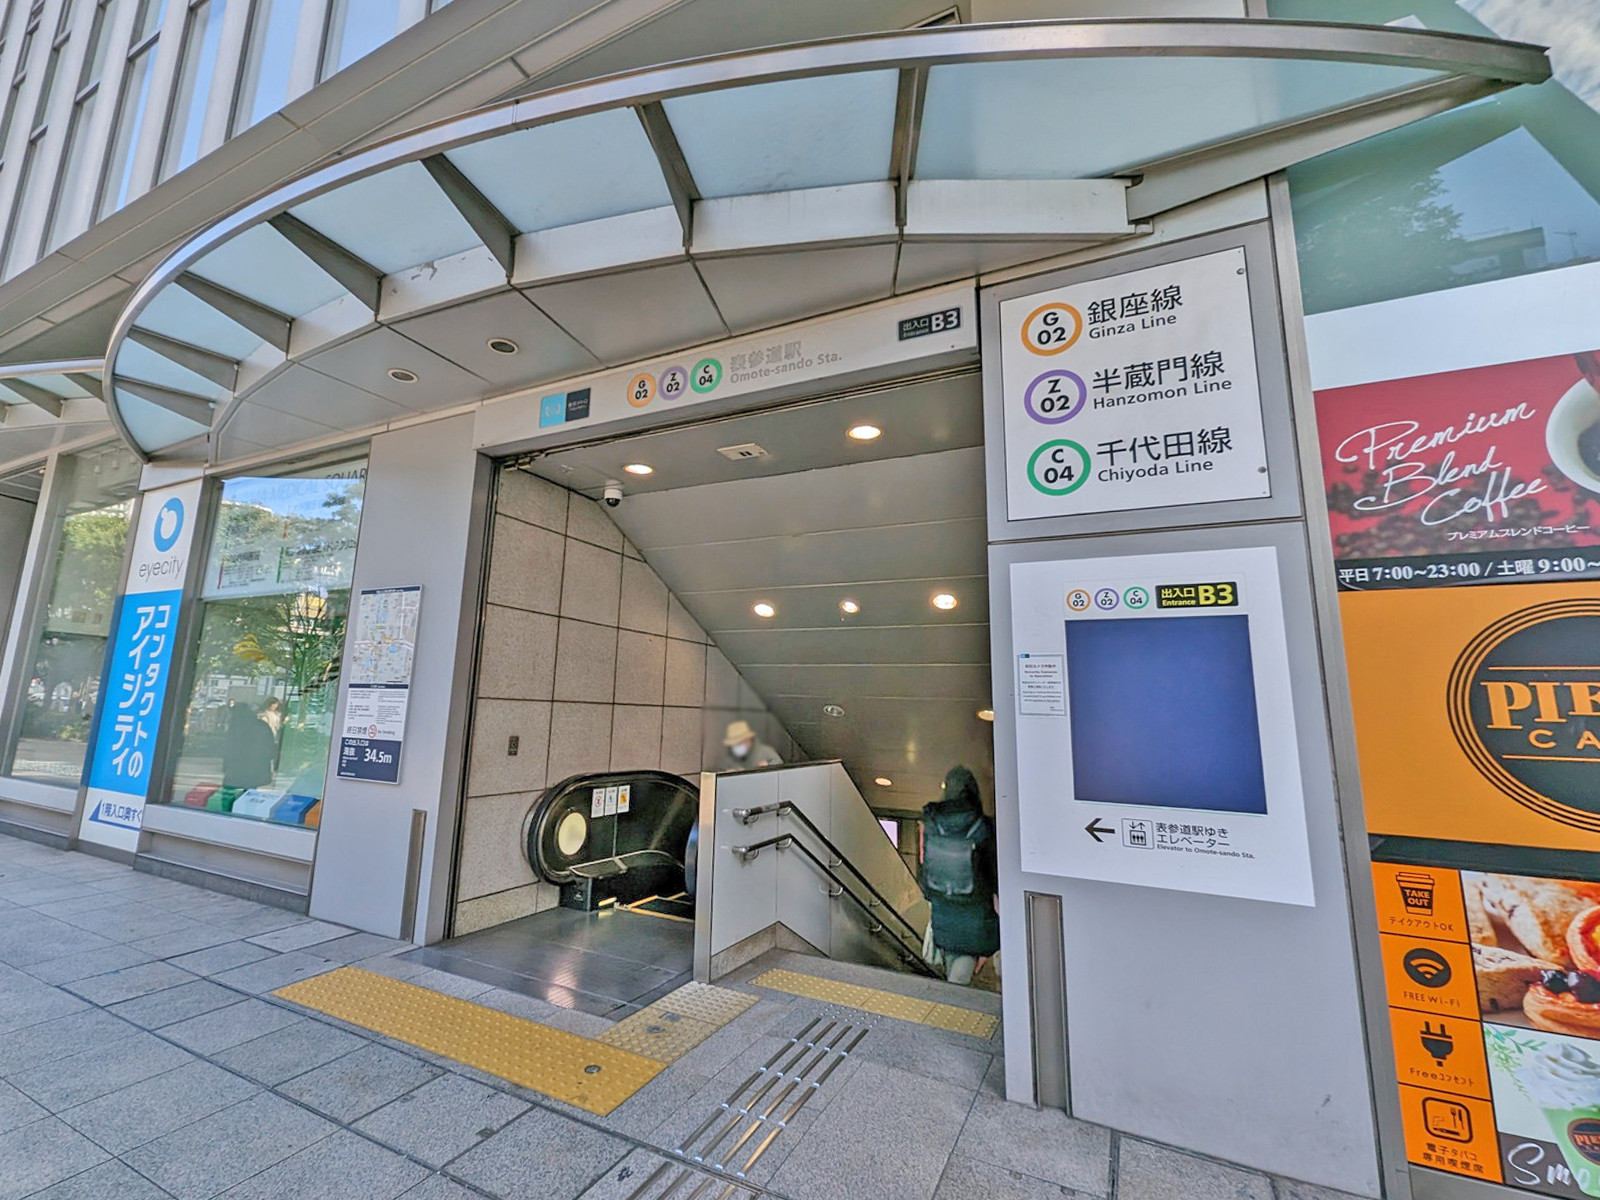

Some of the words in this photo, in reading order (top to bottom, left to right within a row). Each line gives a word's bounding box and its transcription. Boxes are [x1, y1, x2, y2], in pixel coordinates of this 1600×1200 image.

[1087, 285, 1183, 326] 銀座線
[902, 317, 929, 331] 出入口
[931, 310, 958, 331] B3
[1042, 311, 1060, 327] G
[1088, 323, 1136, 340] Ginza
[1141, 313, 1178, 330] Line
[1037, 326, 1067, 345] 02
[729, 340, 802, 372] 表参道駅
[670, 372, 677, 382] Z
[703, 365, 710, 374] C
[730, 357, 813, 384] Omote-sando
[816, 352, 842, 366] Sta.
[1092, 350, 1225, 394] 半蔵門線
[638, 380, 646, 389] G
[666, 382, 681, 393] 02
[699, 374, 714, 386] 04
[1047, 379, 1062, 394] Z
[634, 389, 648, 400] 02
[1093, 386, 1187, 410] Hanzomon
[1194, 379, 1232, 395] Line
[1040, 395, 1071, 414] 02
[1335, 402, 1536, 470] Premium
[1096, 426, 1233, 467] 千代田線
[1051, 448, 1065, 464] C
[1043, 465, 1075, 484] 04
[1097, 464, 1169, 483] Chiyoda
[1176, 460, 1214, 475] Line
[1353, 446, 1502, 511] Blend
[1420, 466, 1548, 526] Coffee
[1447, 525, 1590, 541] プレミアムブレンドコーヒー
[138, 556, 183, 582] eyecity
[1338, 567, 1369, 583] 平日
[1497, 559, 1535, 576] 土曜
[1072, 599, 1084, 607] 02
[1101, 598, 1113, 606] 02
[1130, 597, 1142, 605] 04
[1161, 588, 1195, 599] 出入口
[1198, 583, 1234, 605] B3
[1162, 599, 1196, 607] Entrance
[112, 606, 156, 776] アイシティ
[128, 605, 171, 778] コンタクトの
[363, 747, 392, 765] 34.5m
[1155, 822, 1229, 839] 表参道駅ゆき
[1157, 834, 1230, 848] エレベーター
[1194, 848, 1240, 858] Omote-sando
[1404, 889, 1431, 899] TAKE
[1407, 897, 1430, 906] OUT
[1389, 916, 1455, 932] テイクアウトOK
[1403, 991, 1426, 1002] FREE
[1410, 1067, 1475, 1087] Freeコンセント
